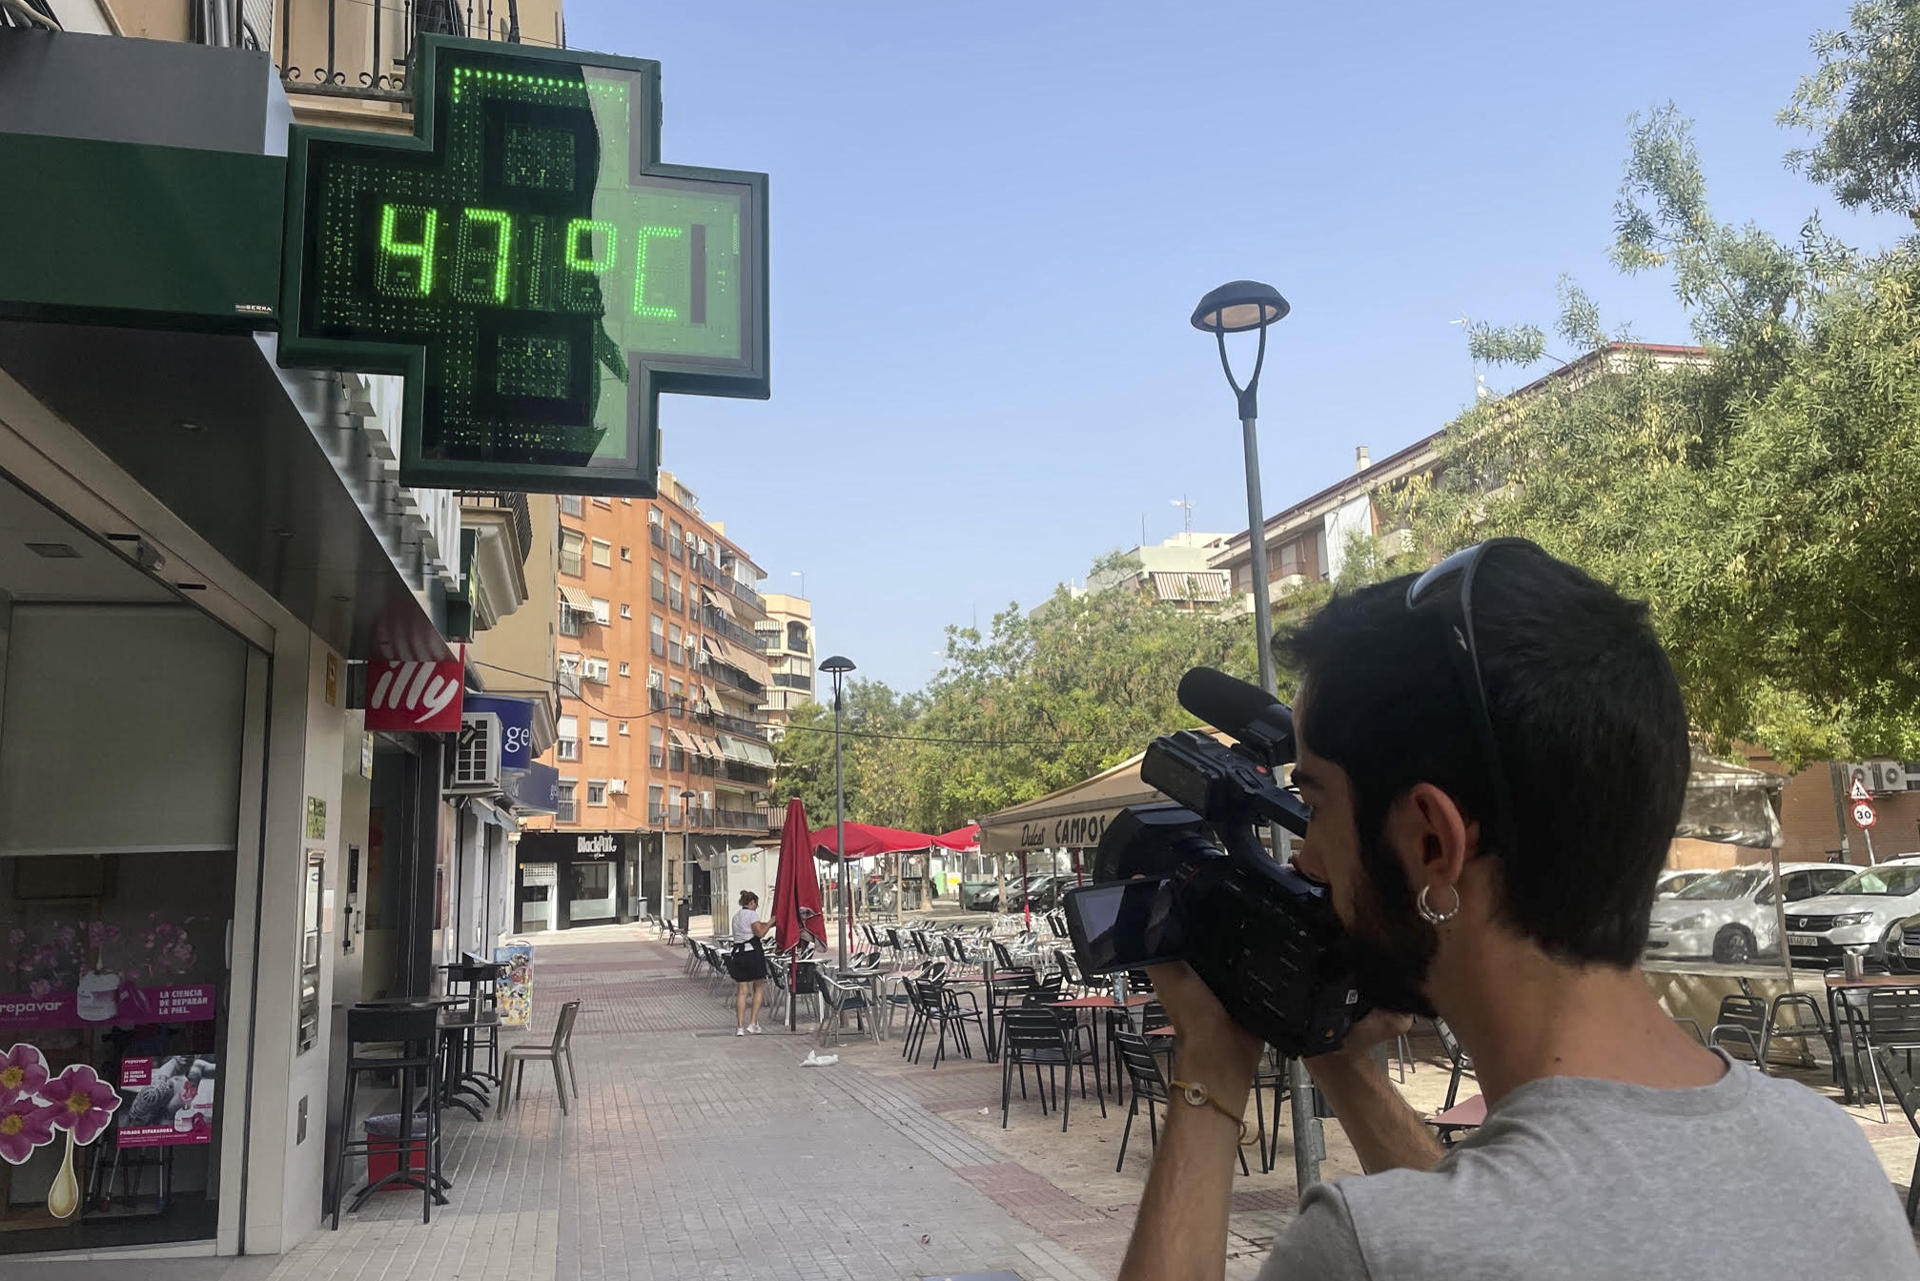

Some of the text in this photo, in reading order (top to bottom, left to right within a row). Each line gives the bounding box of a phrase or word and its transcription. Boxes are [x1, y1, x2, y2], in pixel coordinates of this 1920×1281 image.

[381, 203, 511, 304] 47
[371, 661, 459, 723] illy
[1857, 810, 1872, 820] 30
[159, 989, 203, 999] LA CIENCIA
[159, 997, 208, 1007] DE REPARAR
[0, 1001, 63, 1016] repavar
[159, 1007, 169, 1015] LA
